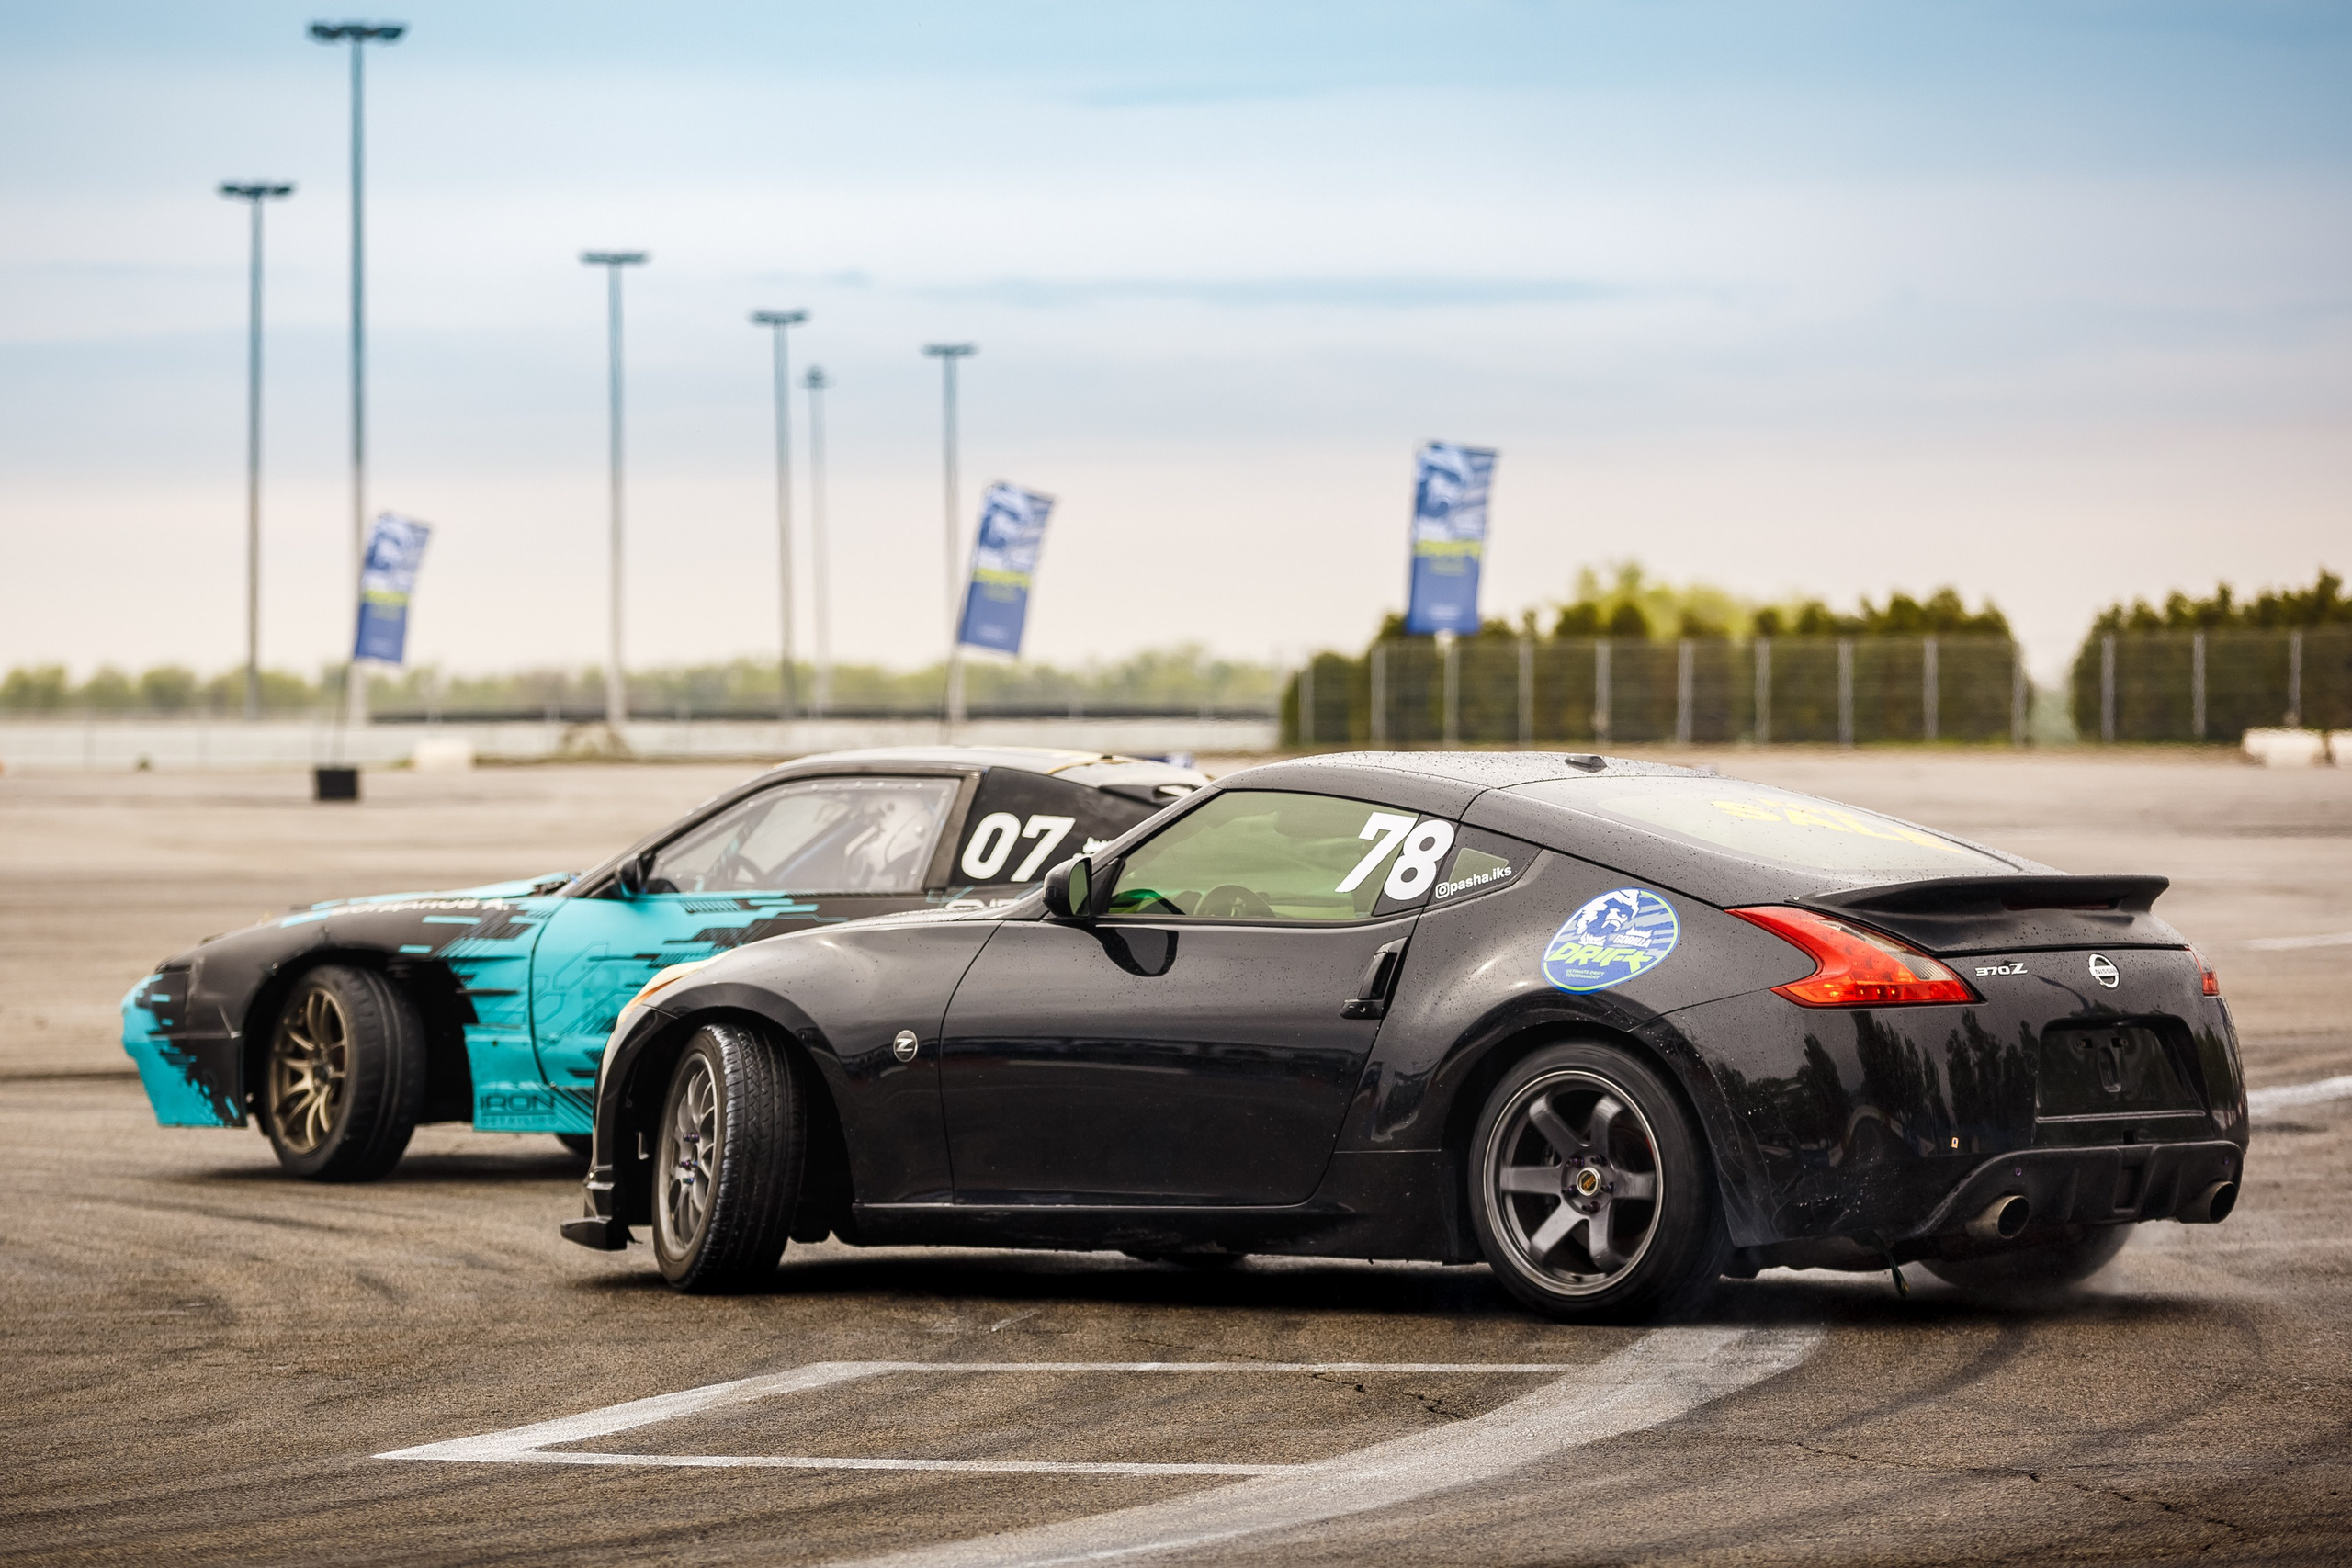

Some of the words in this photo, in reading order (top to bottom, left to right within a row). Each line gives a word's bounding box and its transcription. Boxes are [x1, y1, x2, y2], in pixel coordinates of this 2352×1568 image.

[961, 812, 1076, 882] 07
[1334, 811, 1455, 901] 78
[1450, 865, 1512, 896] pasha.iks
[1612, 933, 1653, 949] GORILLA
[1545, 941, 1654, 974] DRIFT
[1975, 963, 2028, 977] 370Z
[896, 1038, 914, 1053] Z
